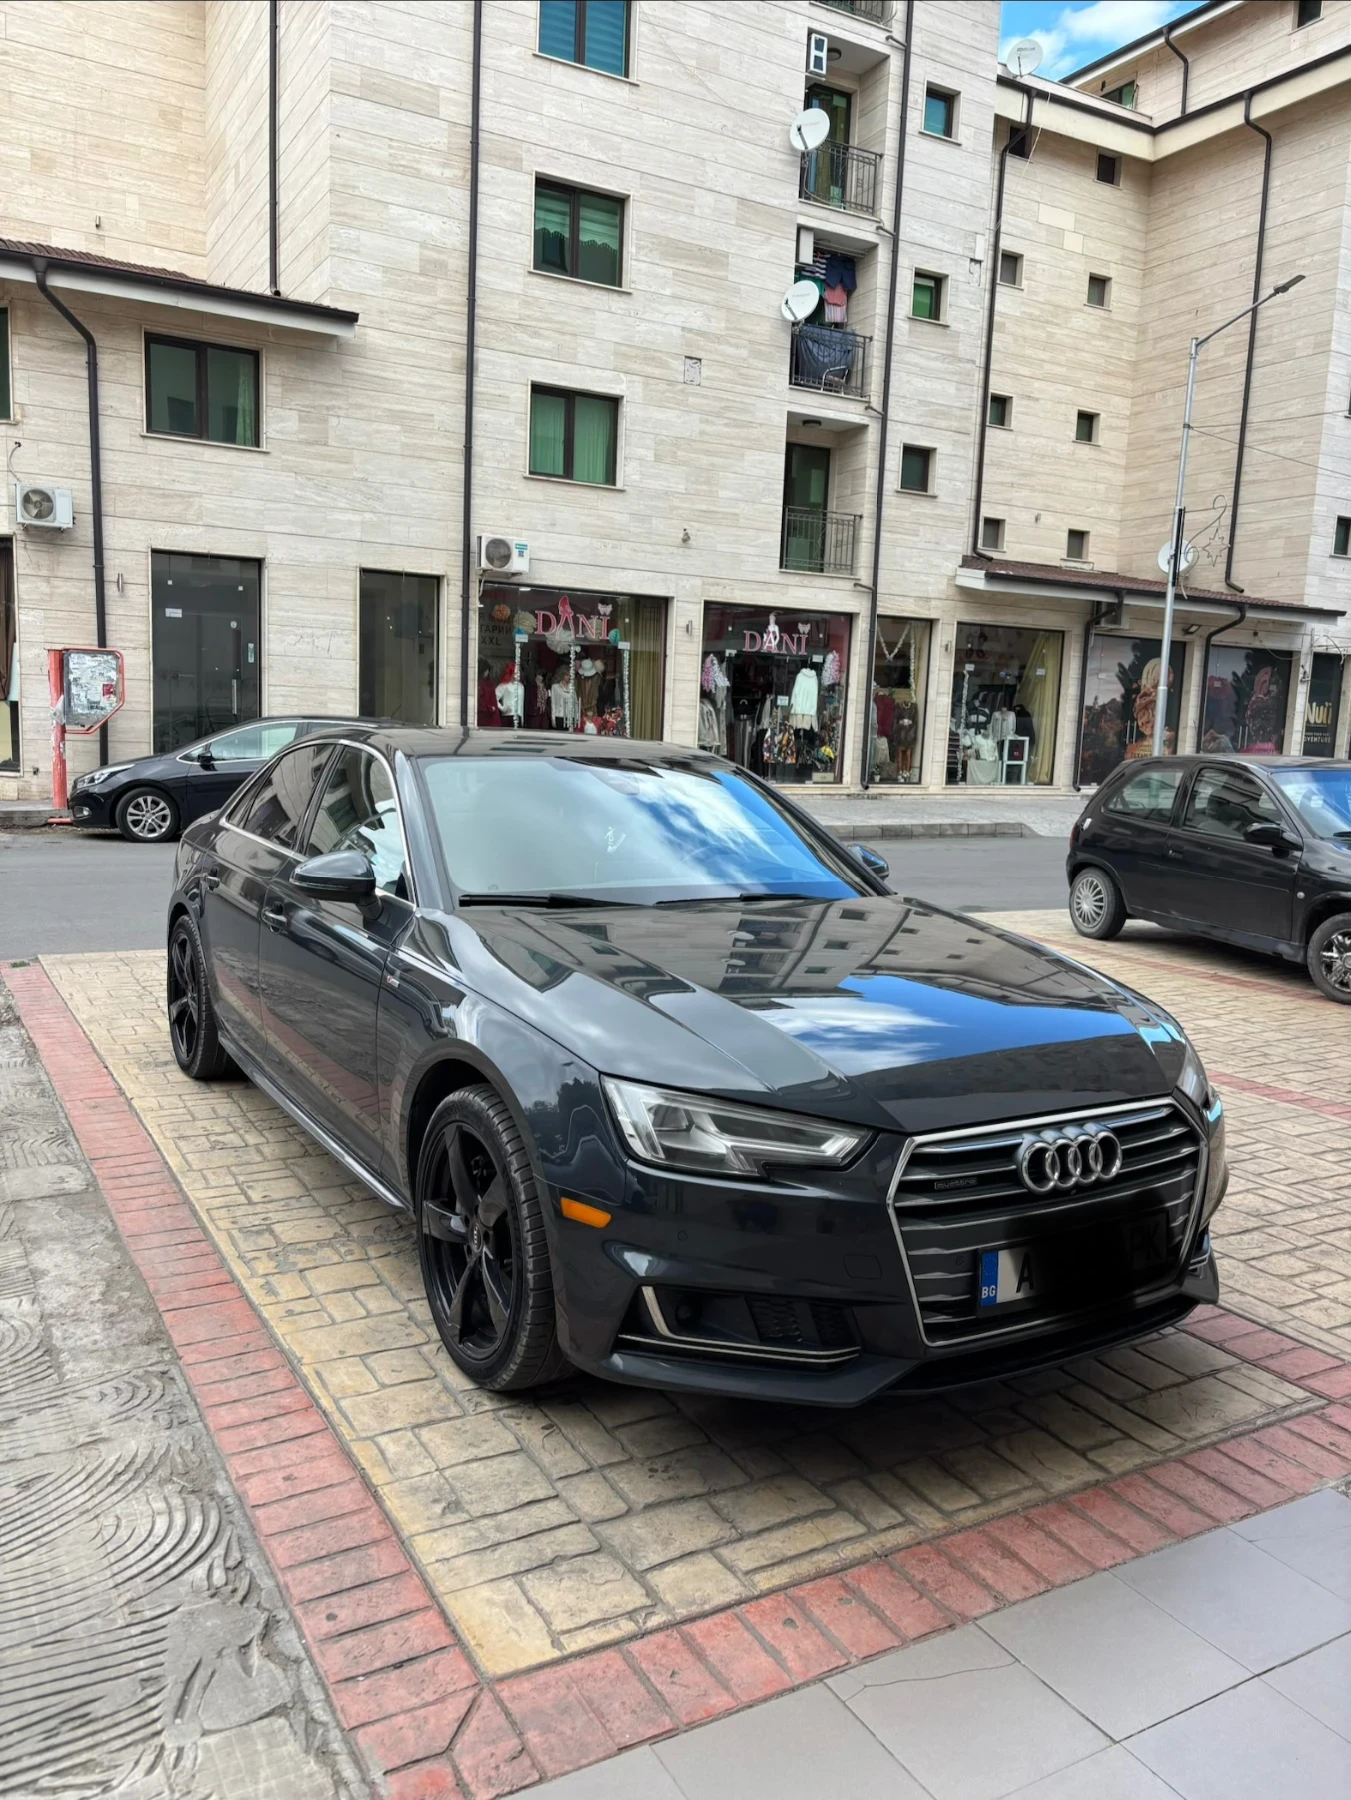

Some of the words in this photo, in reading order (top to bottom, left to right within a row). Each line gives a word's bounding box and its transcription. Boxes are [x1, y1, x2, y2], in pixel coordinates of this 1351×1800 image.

[535, 604, 610, 639] DANI
[742, 628, 809, 655] DANI
[936, 1178, 977, 1189] quattro
[1016, 1252, 1034, 1293] A
[982, 1285, 996, 1298] BG
